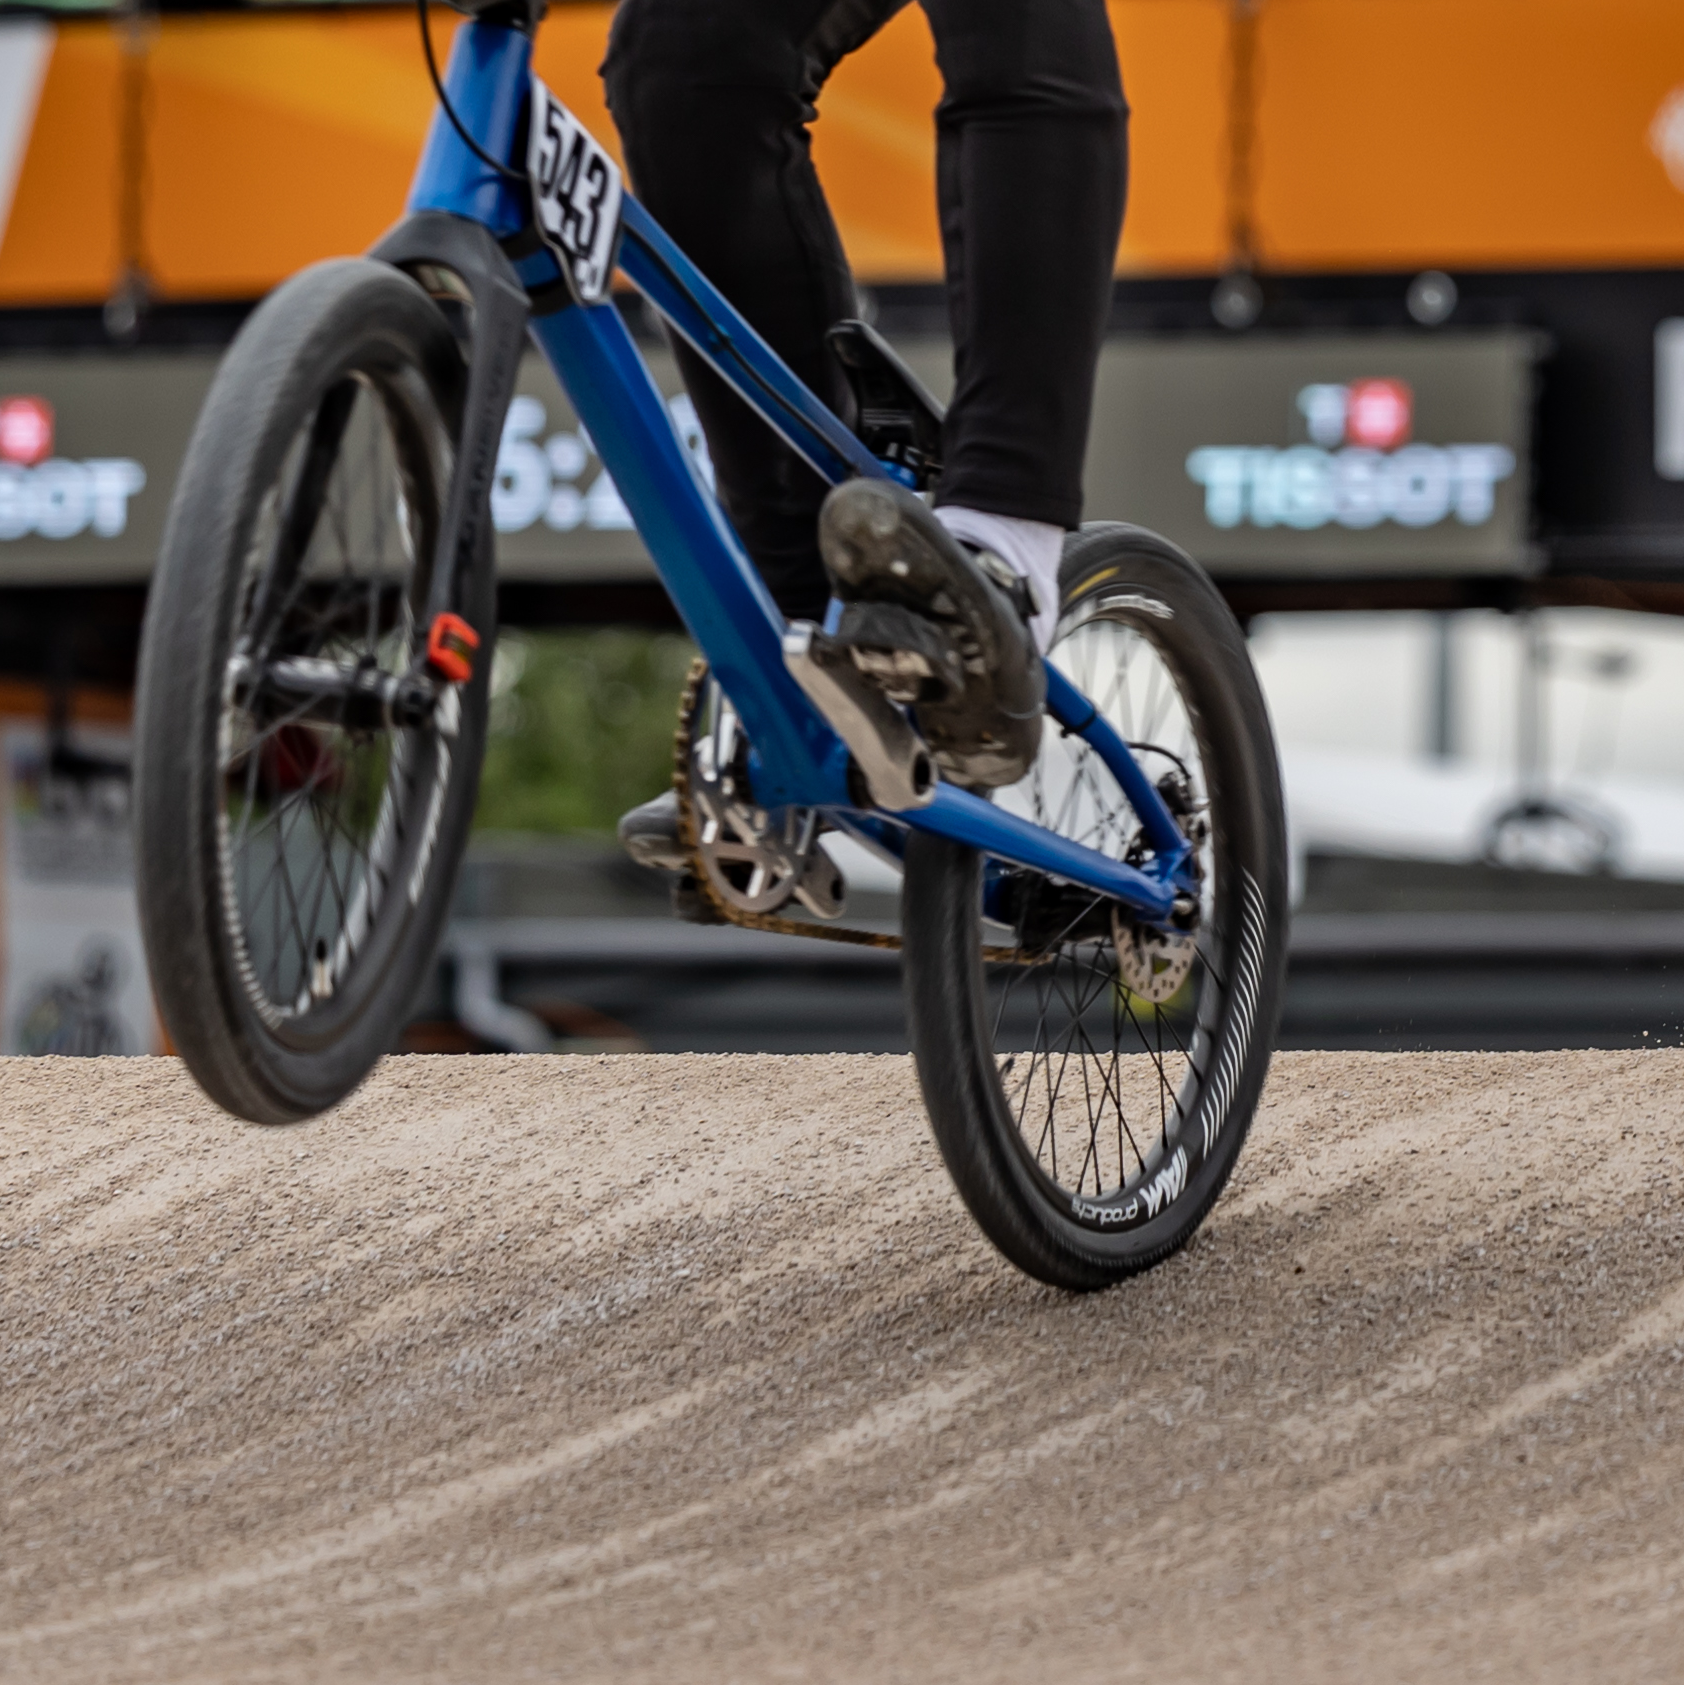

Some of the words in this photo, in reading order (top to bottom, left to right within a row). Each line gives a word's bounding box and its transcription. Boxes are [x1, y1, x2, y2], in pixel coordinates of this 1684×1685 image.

[537, 98, 610, 261] 543
[1186, 443, 1513, 529] TISSOT
[1072, 1196, 1139, 1226] products
